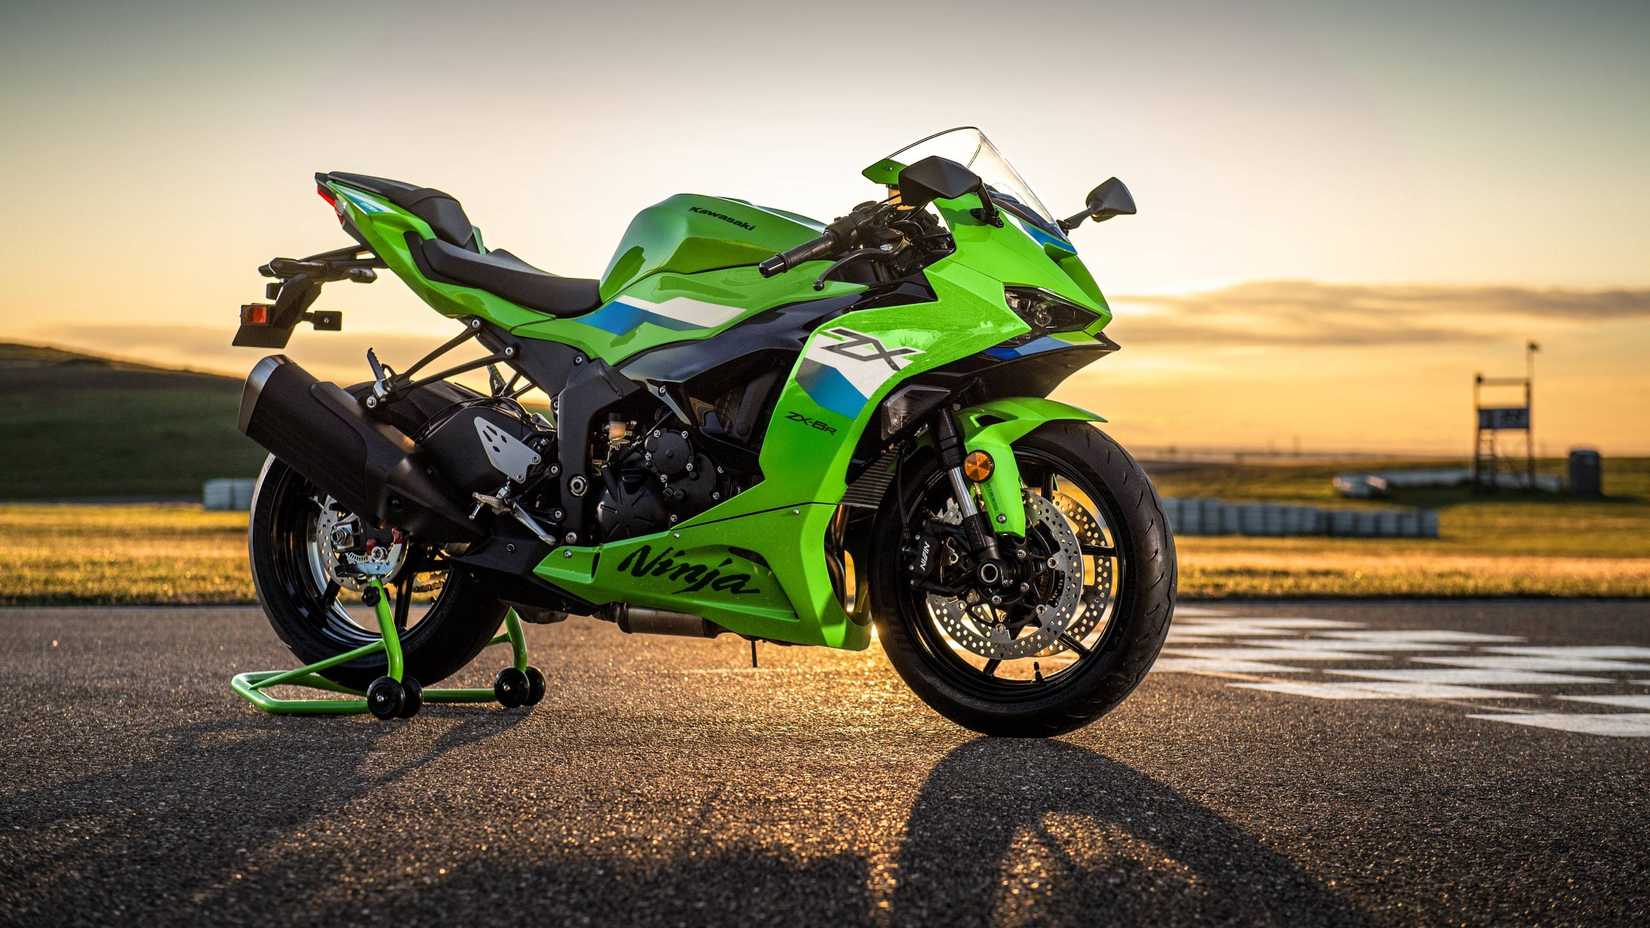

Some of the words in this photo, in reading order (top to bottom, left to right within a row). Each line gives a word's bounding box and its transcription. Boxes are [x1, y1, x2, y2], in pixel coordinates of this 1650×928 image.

[688, 206, 756, 231] Kawasaki
[820, 328, 917, 371] ZX
[785, 411, 837, 436] ZX-6R
[617, 544, 760, 594] Ninja
